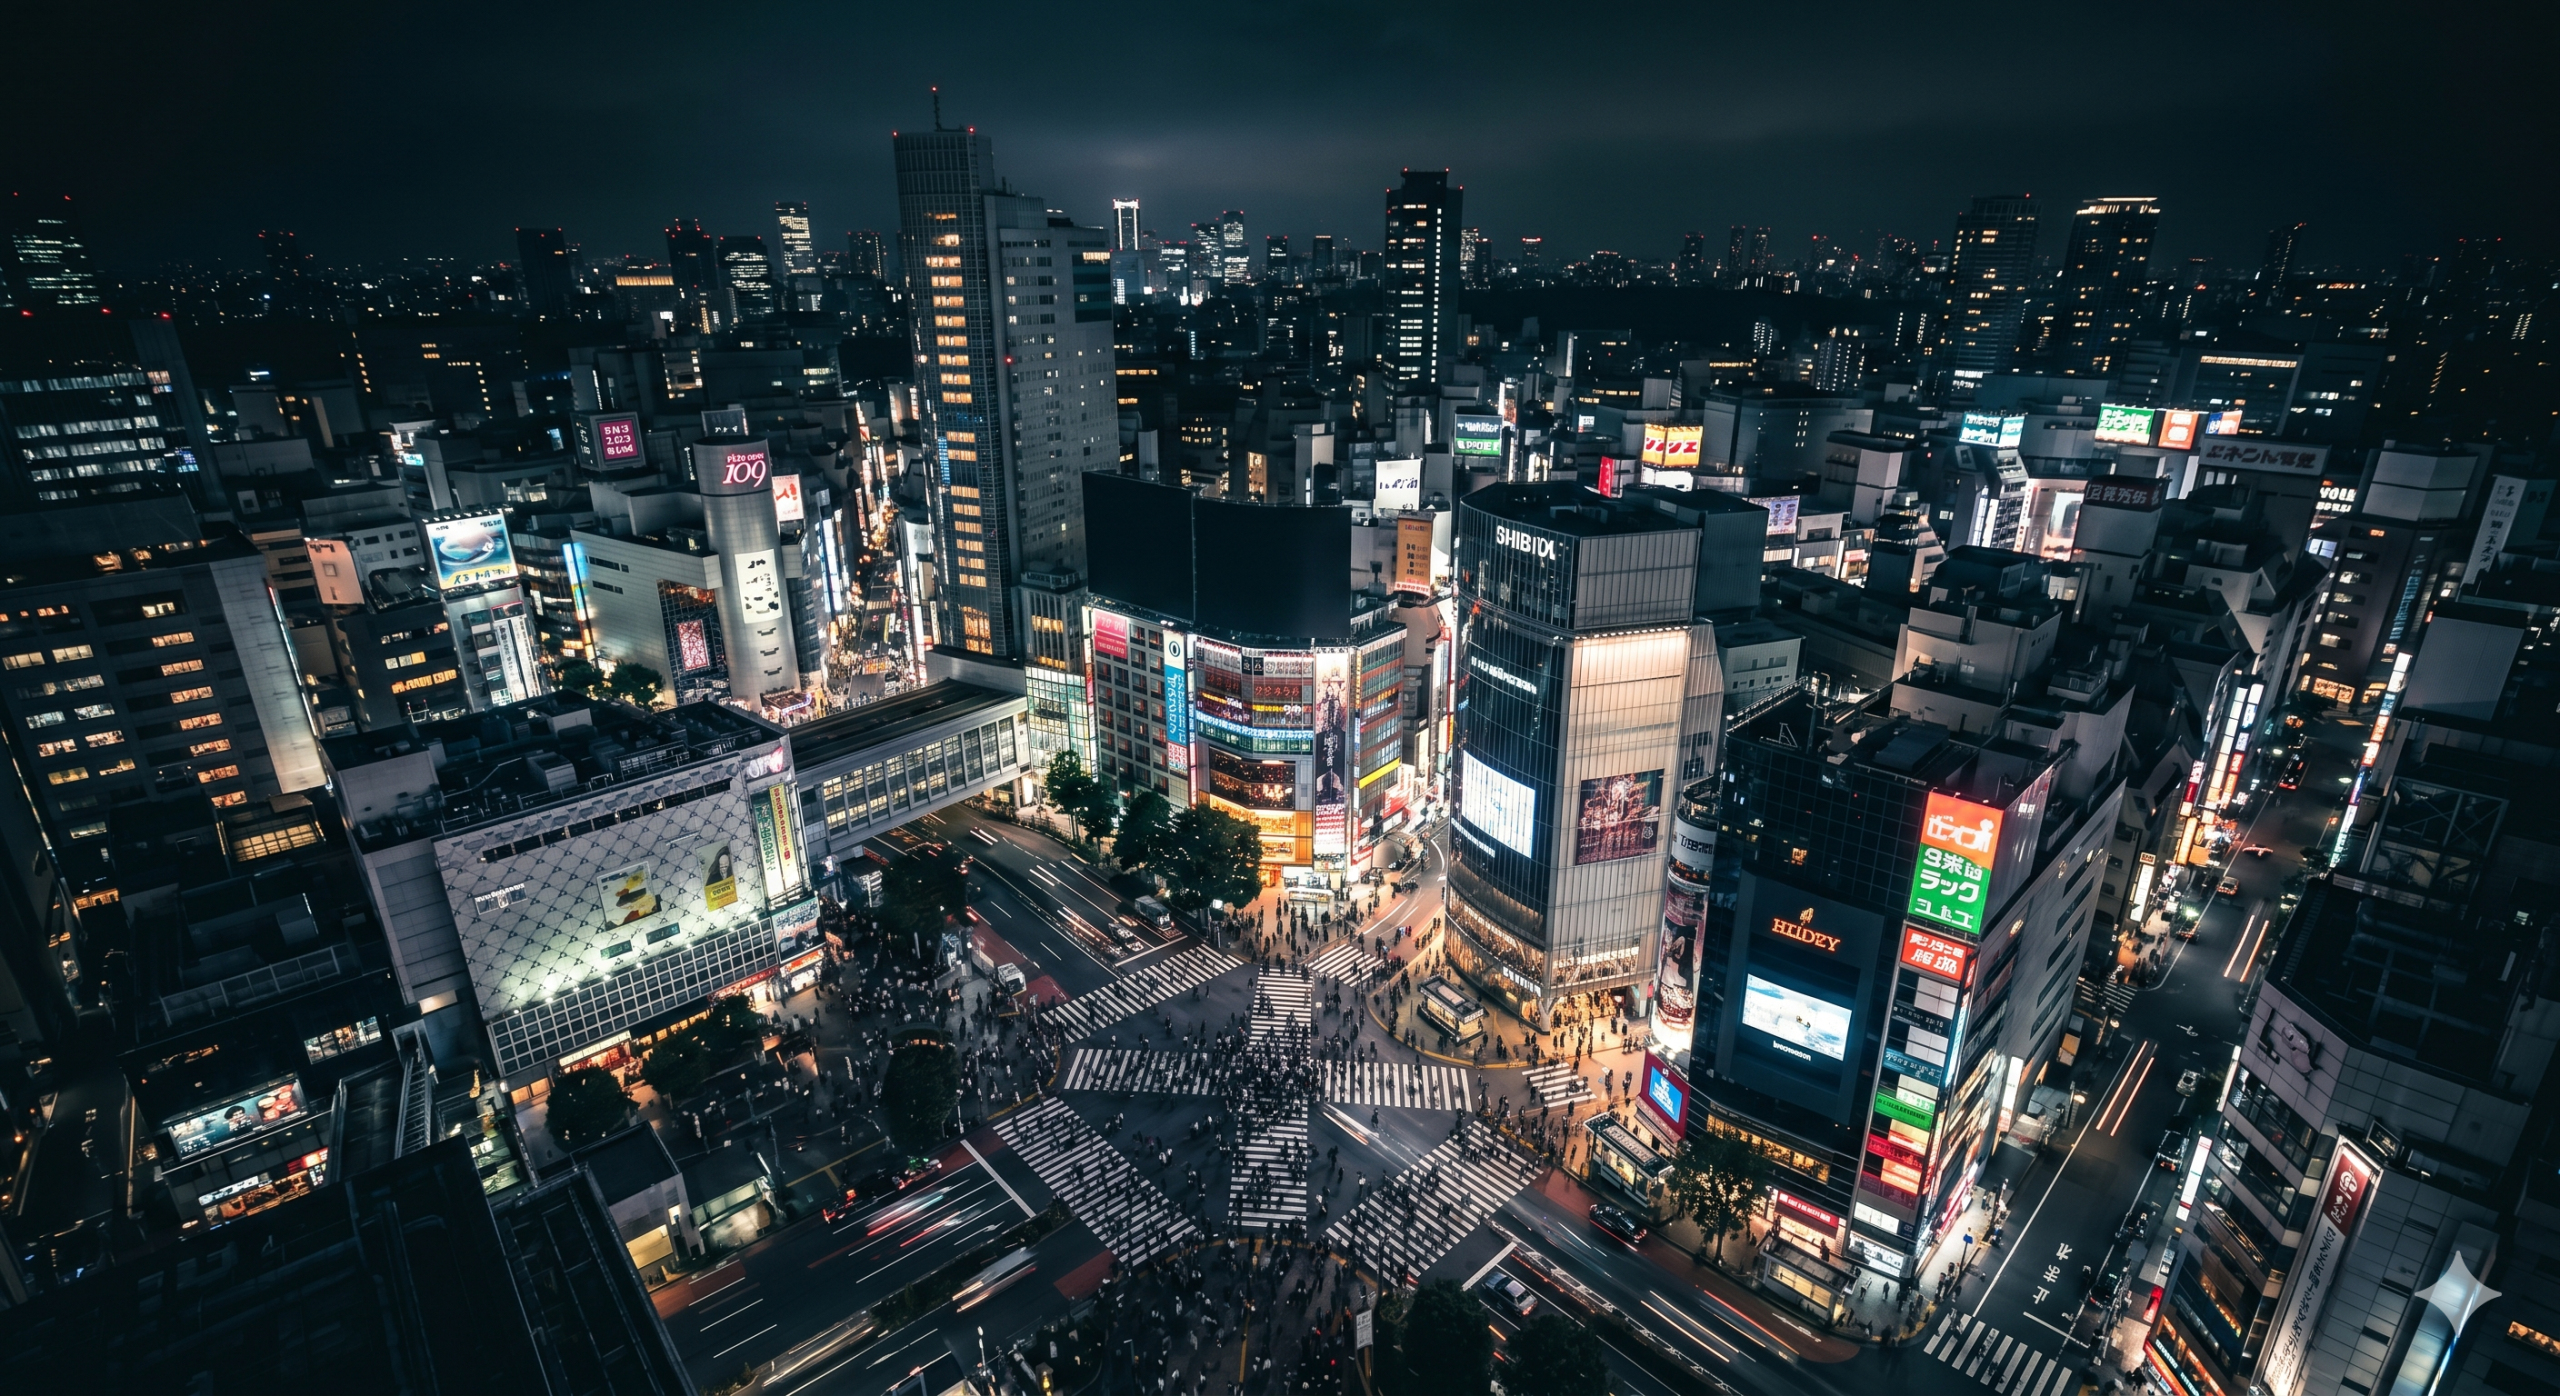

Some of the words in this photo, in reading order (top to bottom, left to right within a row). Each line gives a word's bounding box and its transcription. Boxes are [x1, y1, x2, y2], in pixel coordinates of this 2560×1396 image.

[722, 460, 767, 488] 109
[1920, 868, 1981, 904] ラック
